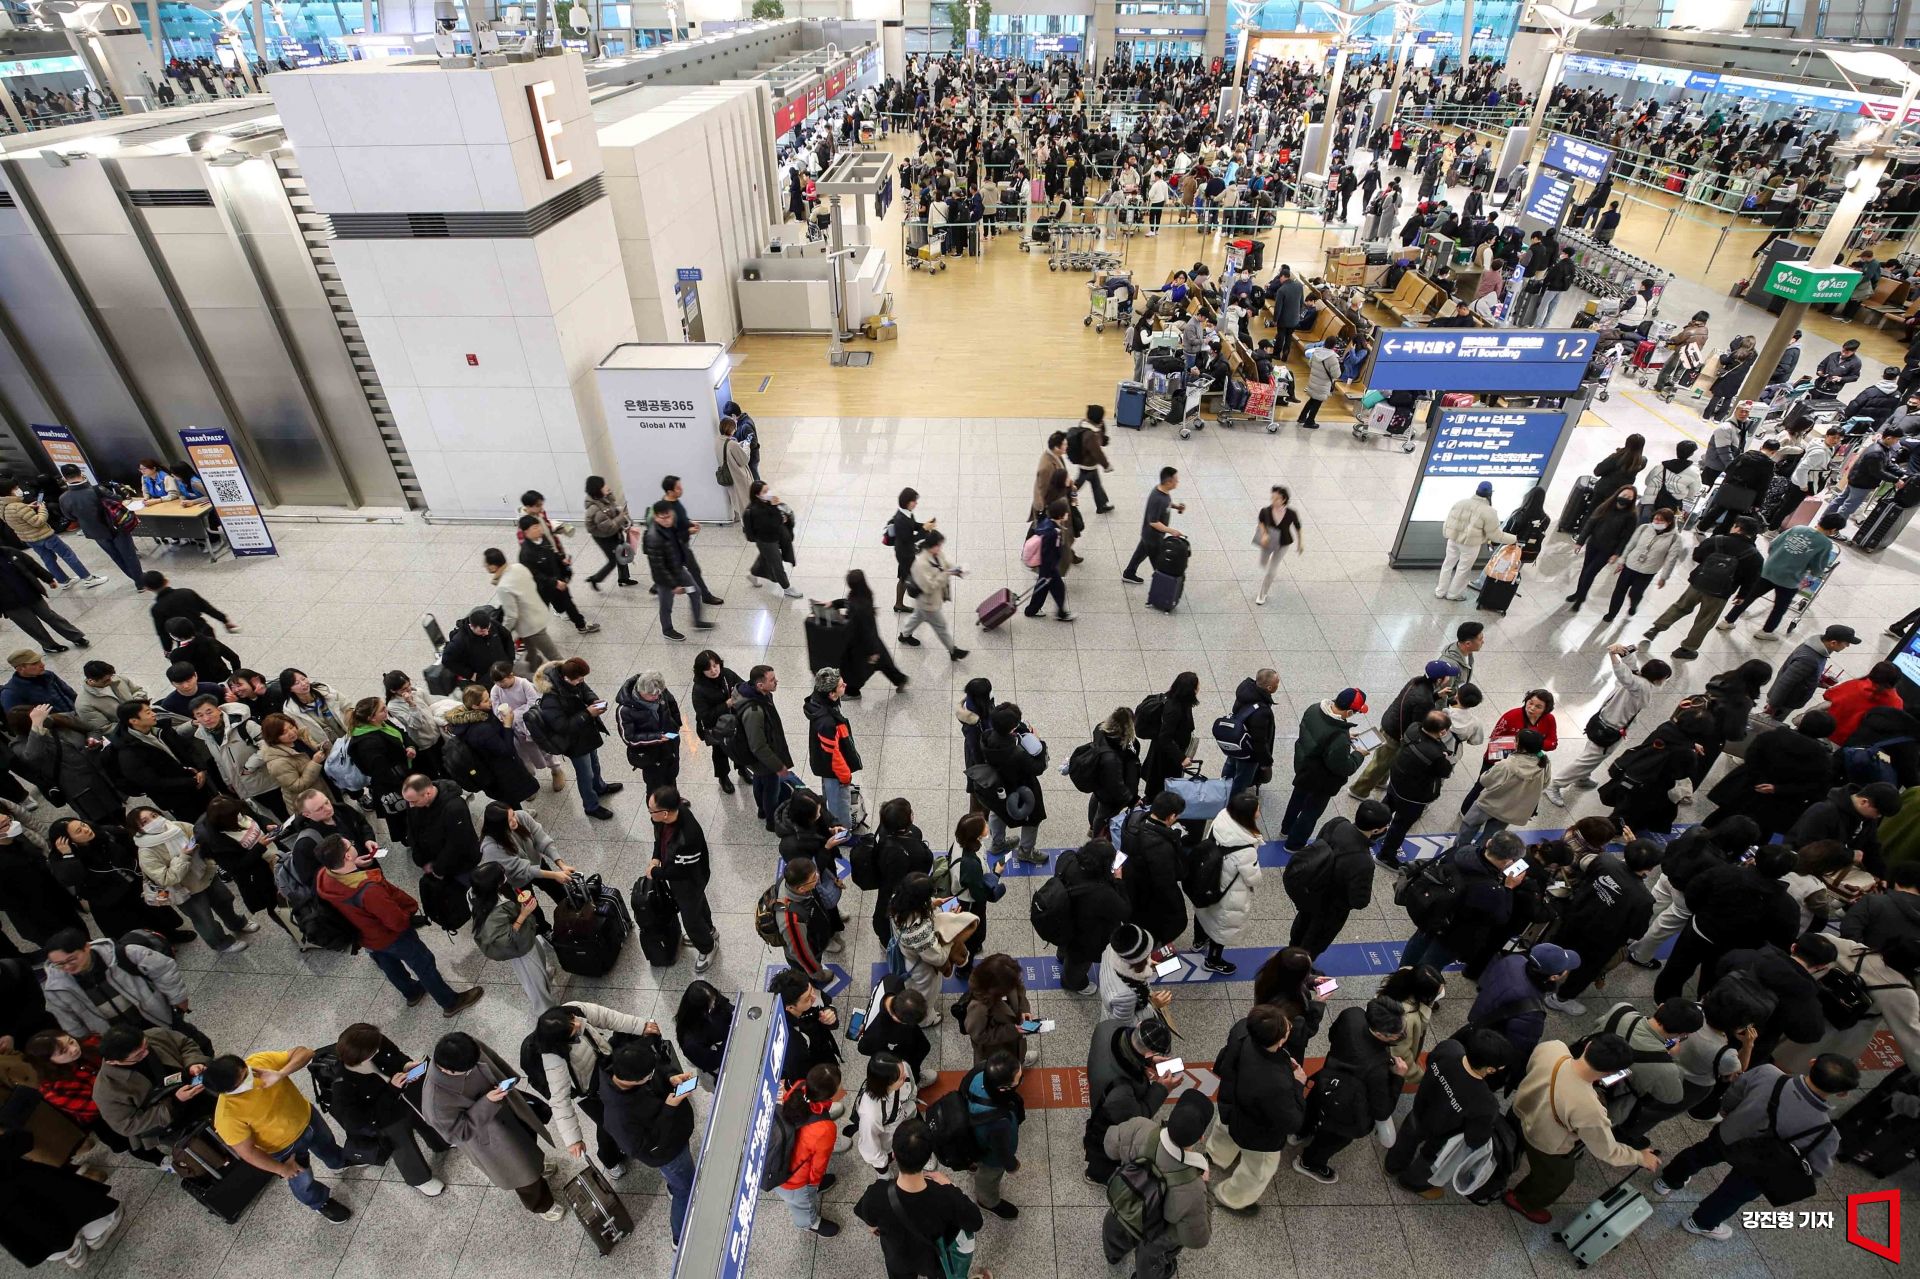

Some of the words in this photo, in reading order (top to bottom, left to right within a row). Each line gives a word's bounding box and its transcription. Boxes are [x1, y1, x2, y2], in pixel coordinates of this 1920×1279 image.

[111, 3, 132, 26] D
[524, 79, 573, 181] E
[1786, 275, 1802, 285] AED
[1829, 281, 1848, 289] AED
[1478, 348, 1521, 360] Boarding
[1556, 338, 1588, 360] 1,2
[624, 400, 694, 412] 은행공동365
[185, 434, 224, 442] SMARTPASS
